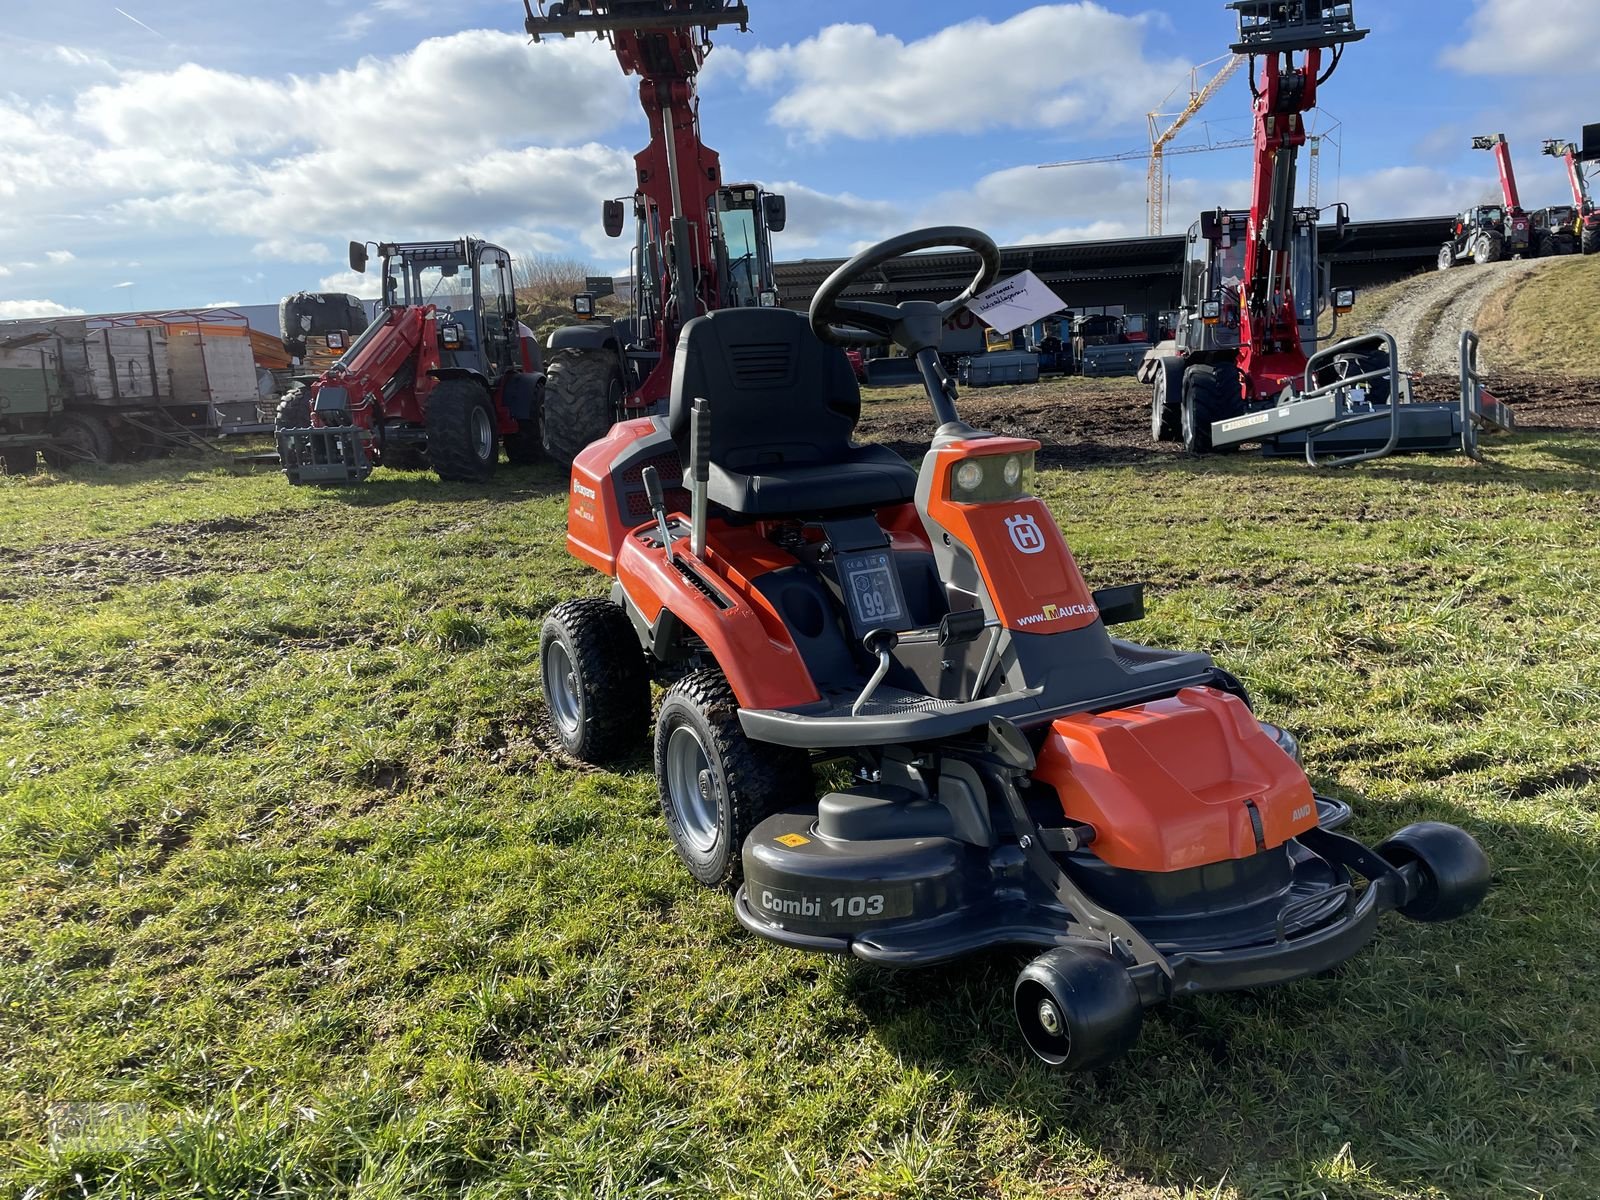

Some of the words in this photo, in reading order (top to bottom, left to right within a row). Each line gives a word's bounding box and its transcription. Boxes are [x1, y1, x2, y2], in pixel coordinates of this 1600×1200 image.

[863, 591, 885, 617] 99
[1016, 604, 1097, 626] www.MAUCH.at
[1292, 804, 1311, 822] AWD
[762, 890, 821, 917] Combi
[830, 894, 885, 917] 103
